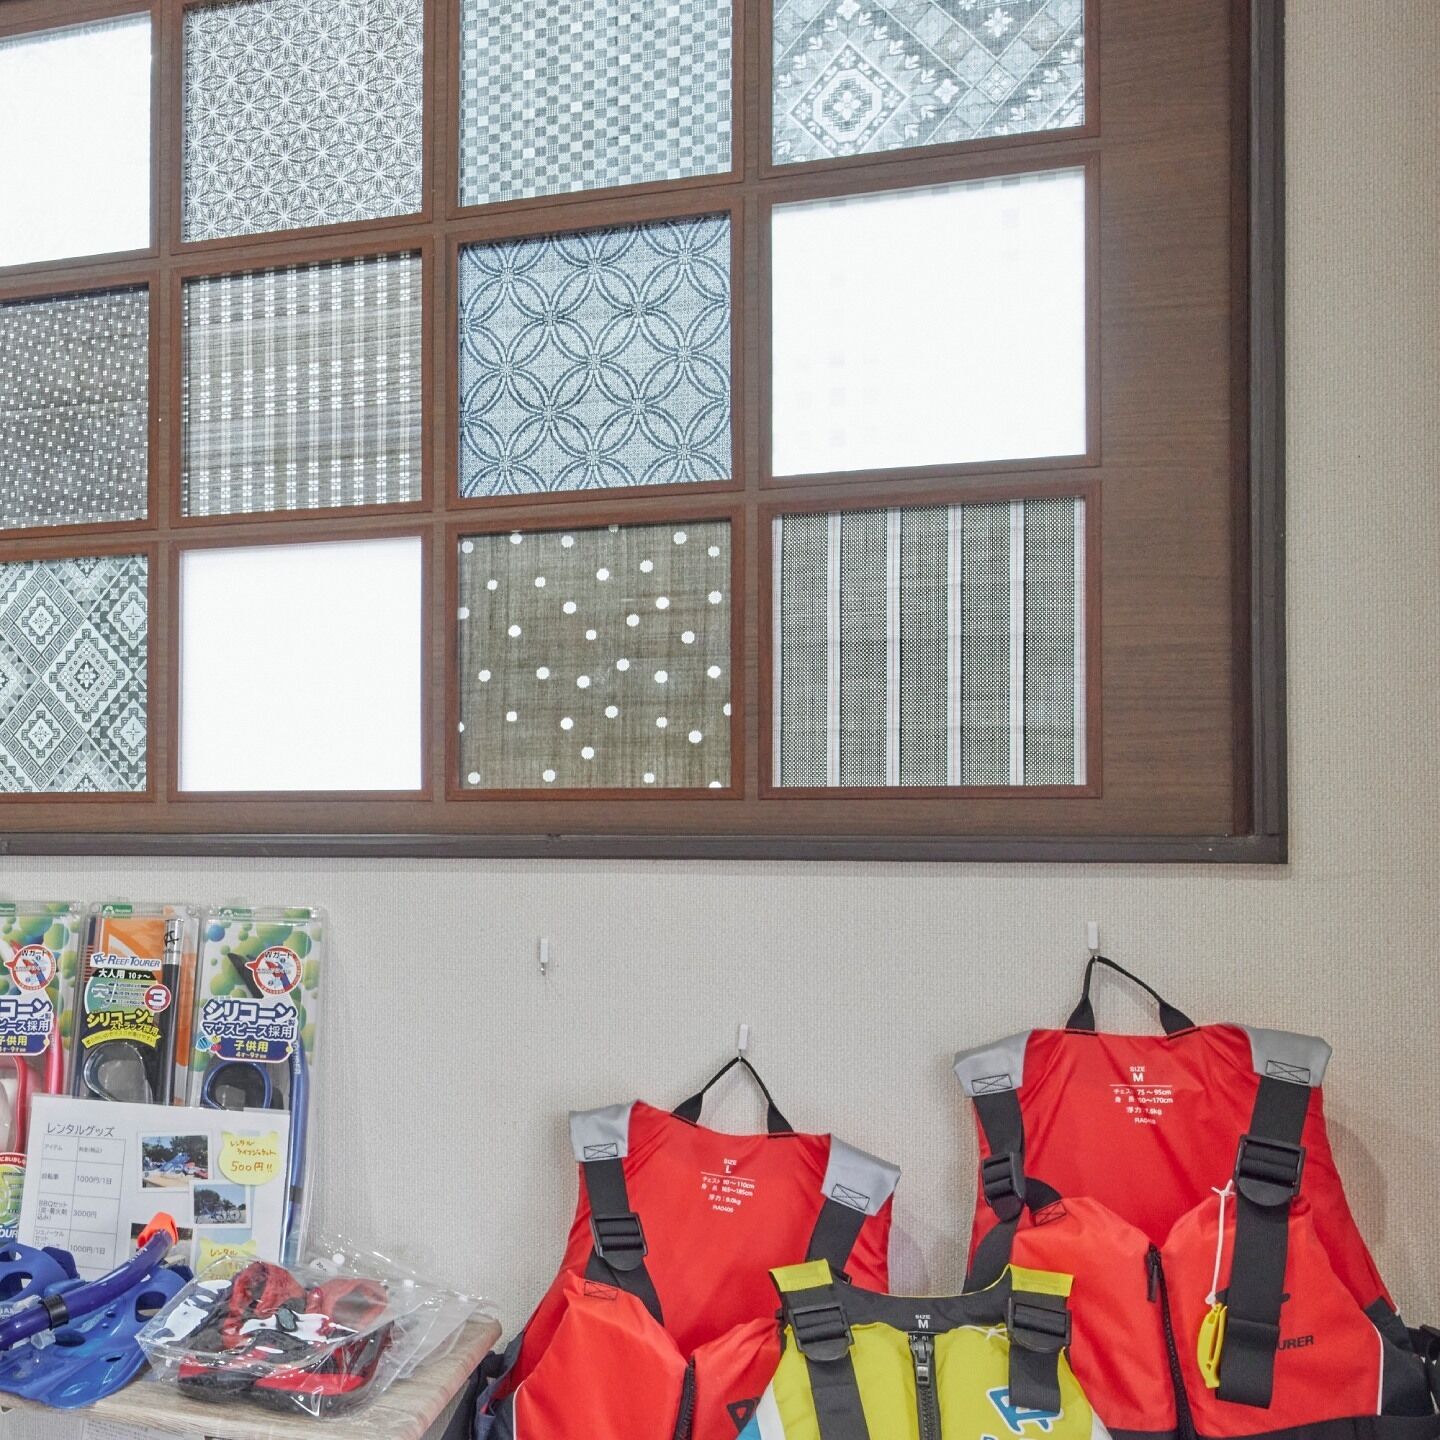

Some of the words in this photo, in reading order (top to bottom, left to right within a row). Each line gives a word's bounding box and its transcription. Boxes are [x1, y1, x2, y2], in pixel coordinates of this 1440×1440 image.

[108, 955, 130, 965] REEF
[130, 956, 160, 967] TOURER
[99, 969, 126, 979] 大人用
[149, 988, 167, 1006] 3
[203, 1022, 294, 1038] マウスピース採用
[234, 1040, 269, 1052] 子供用
[1133, 1073, 1144, 1082] M
[47, 1123, 115, 1137] レンタルグッズ
[725, 1165, 732, 1174] L
[73, 1209, 97, 1219] 3000円
[918, 1319, 929, 1329] M
[1278, 1335, 1314, 1350] URER
